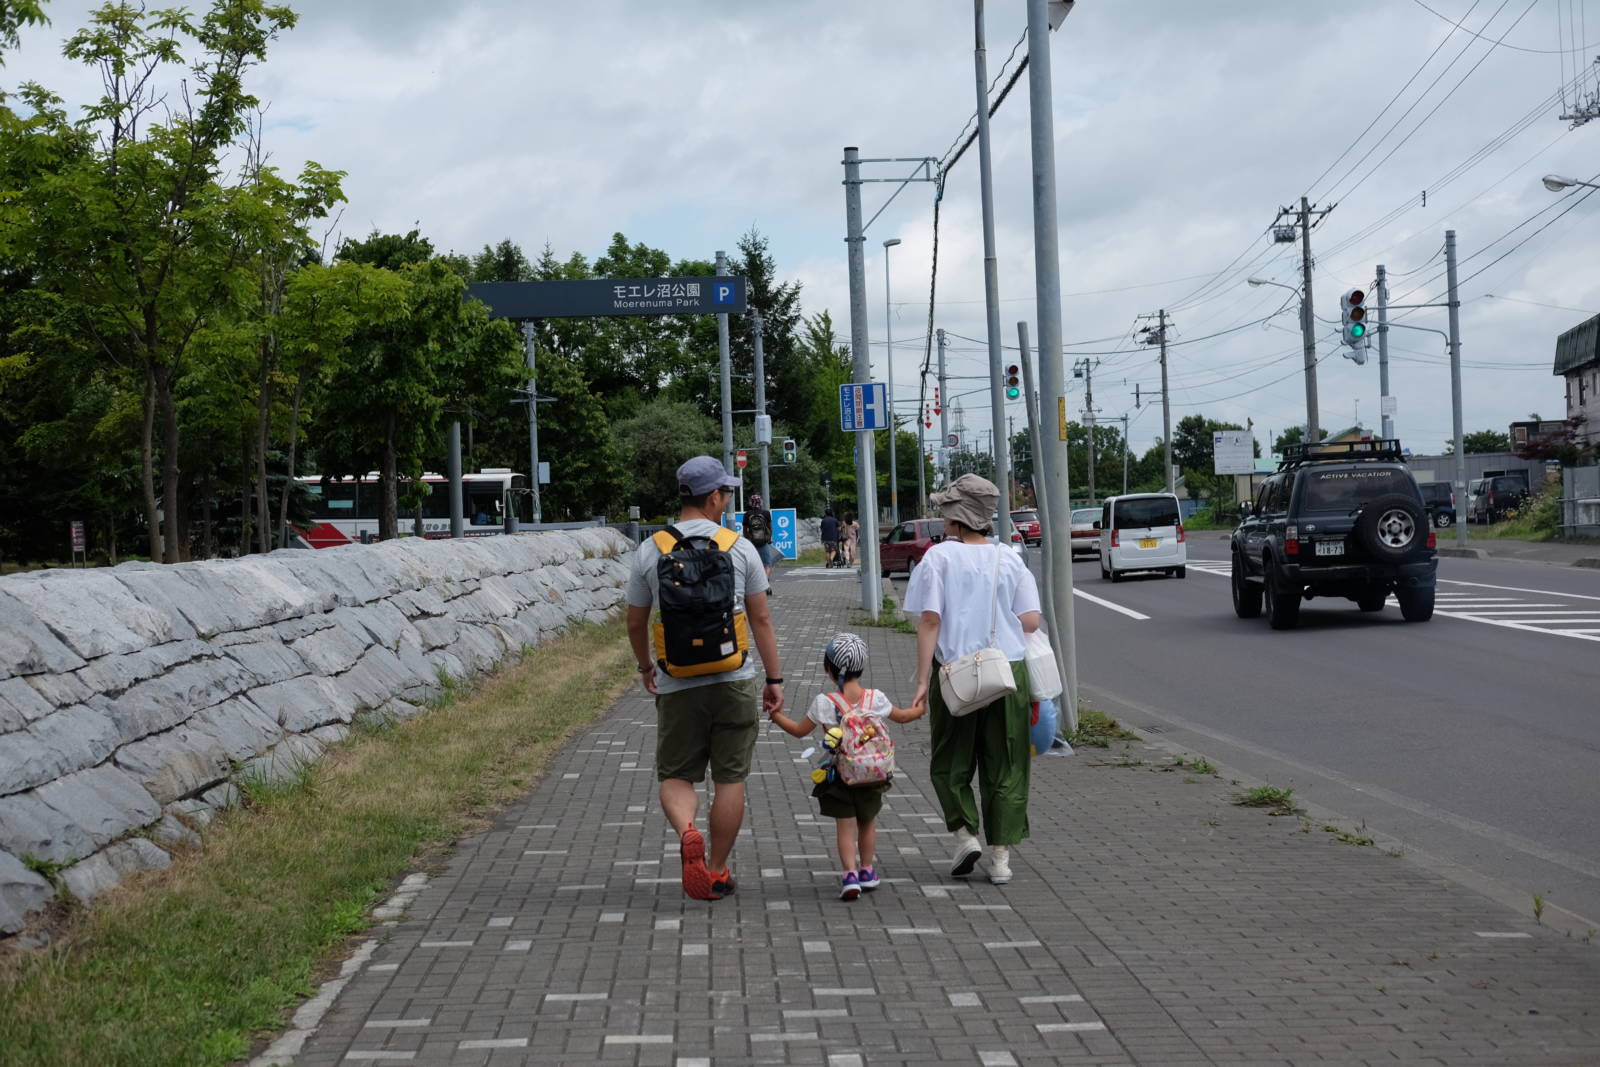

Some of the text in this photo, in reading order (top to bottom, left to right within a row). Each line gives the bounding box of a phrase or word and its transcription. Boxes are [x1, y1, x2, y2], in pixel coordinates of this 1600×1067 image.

[613, 283, 700, 298] モエレ沼公園
[719, 286, 730, 301] P
[613, 298, 700, 308] Moerenuma Park
[776, 541, 792, 549] OUT
